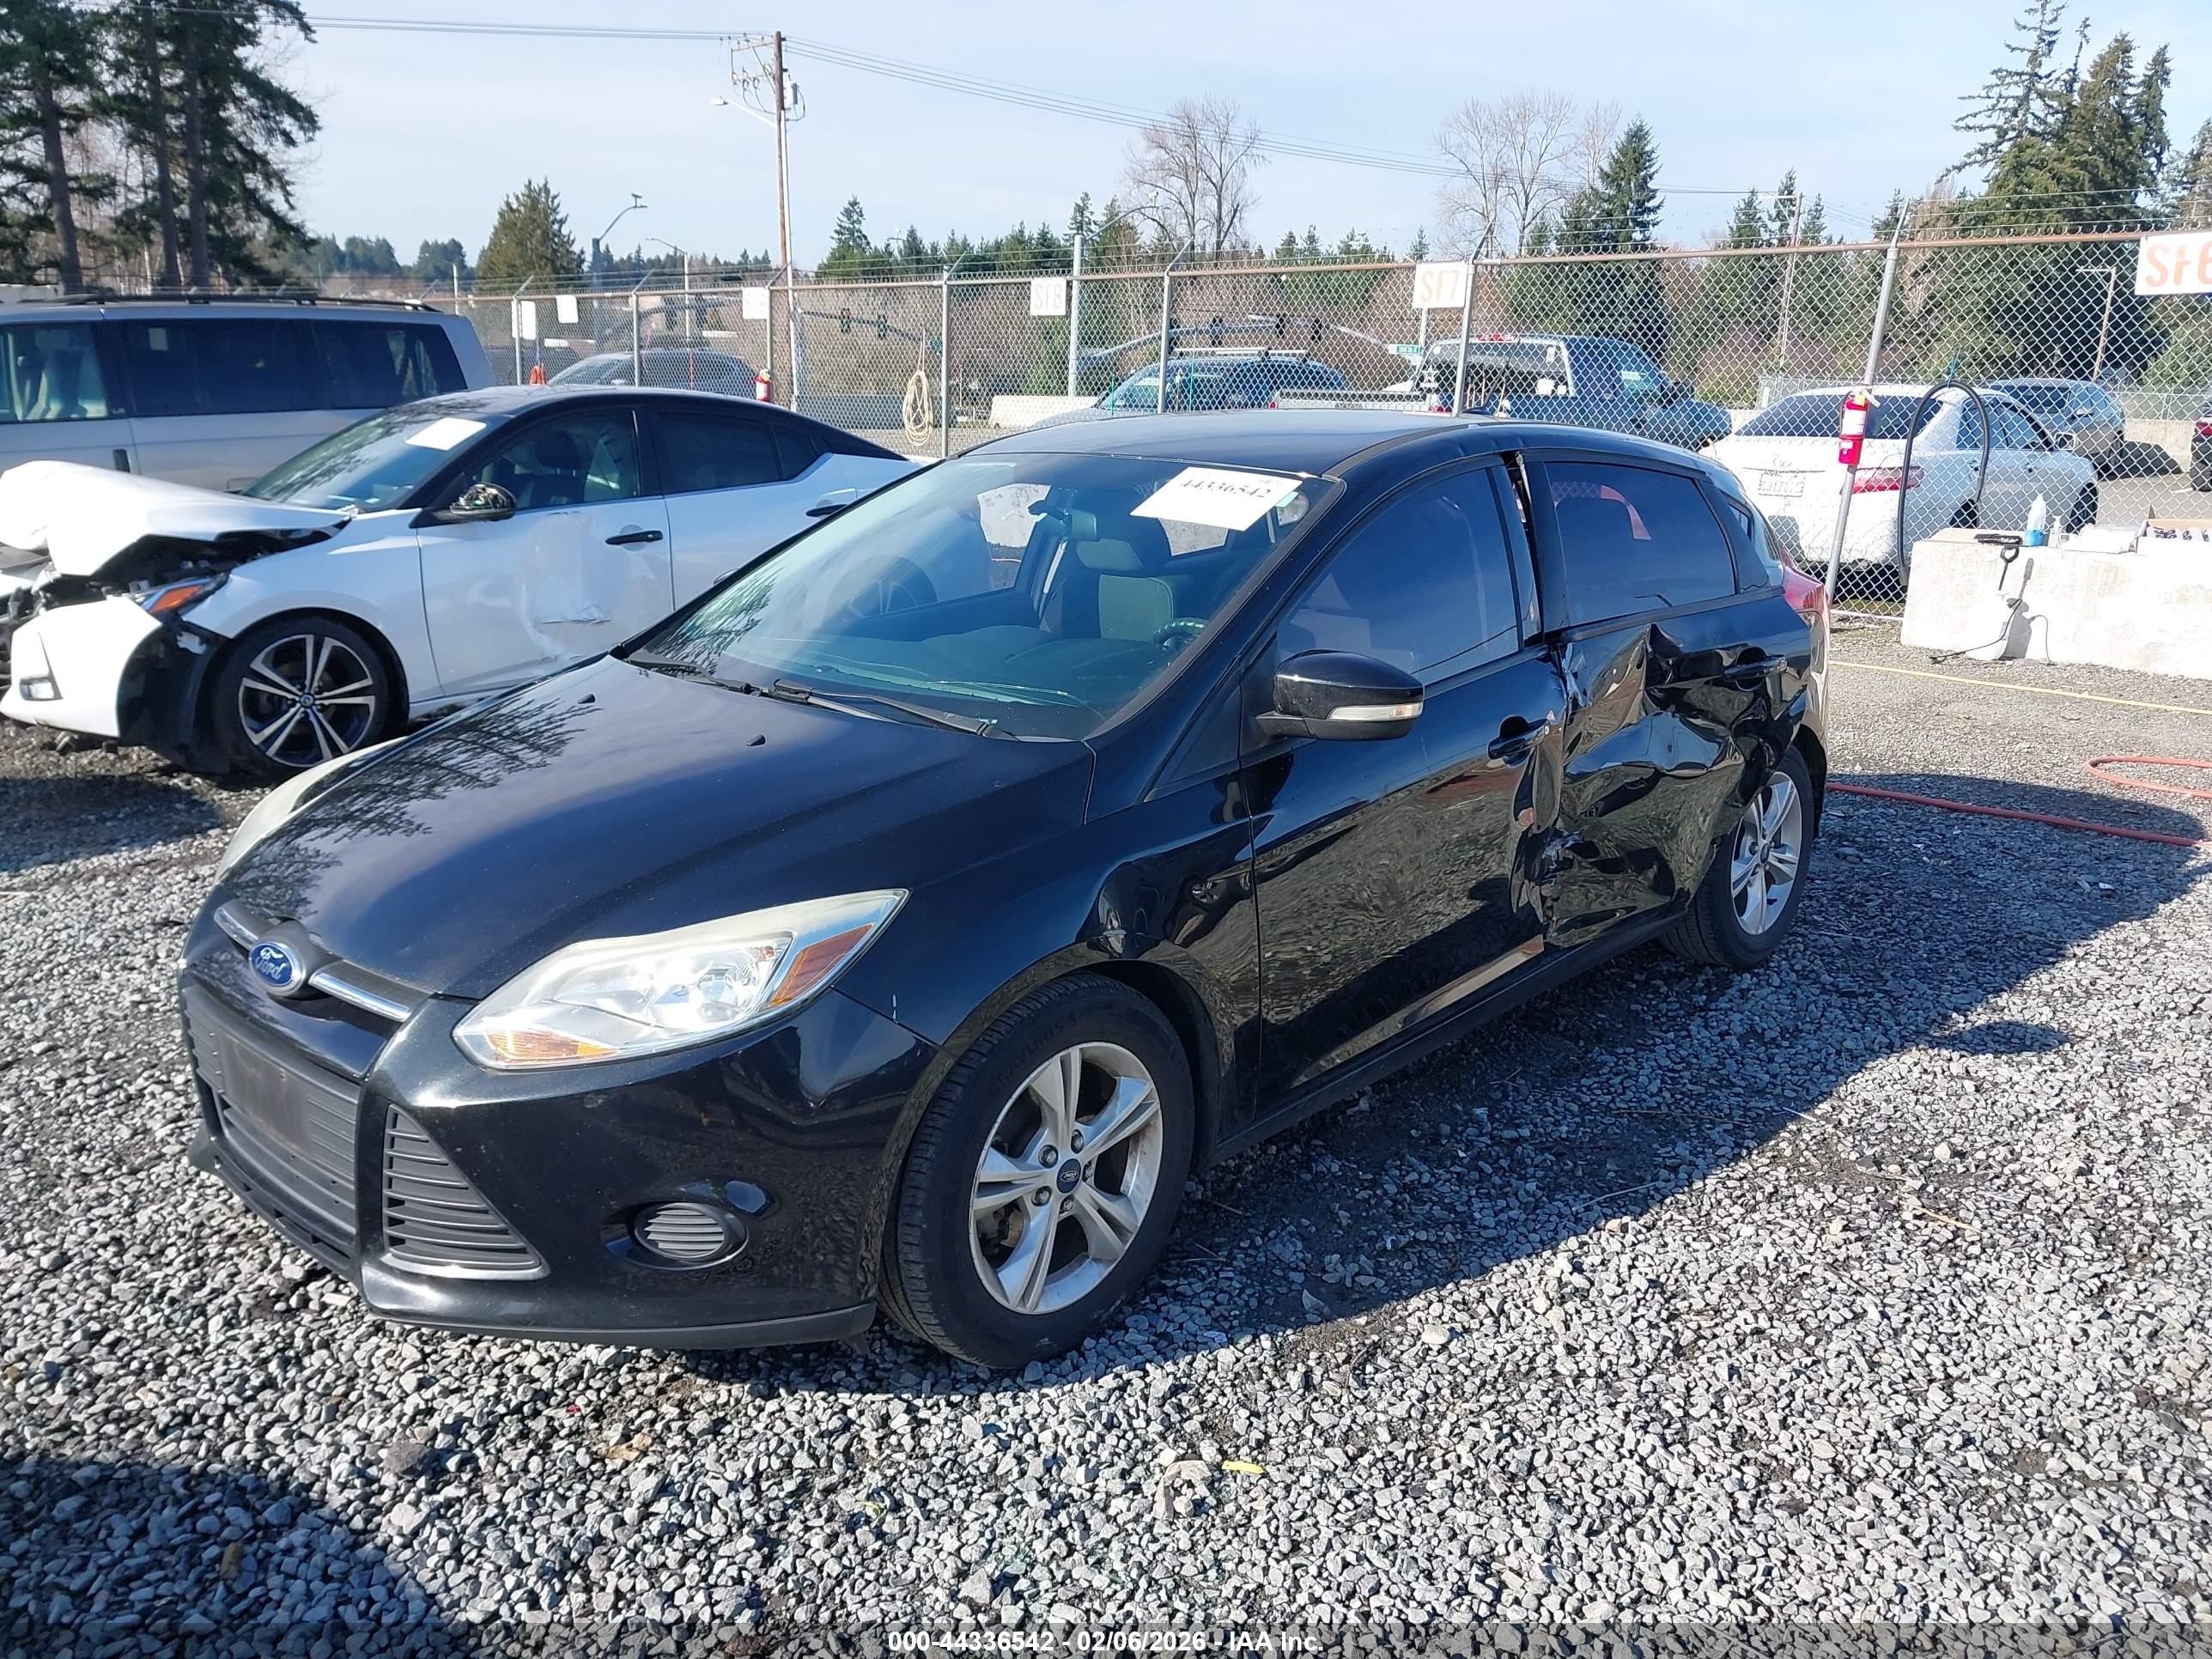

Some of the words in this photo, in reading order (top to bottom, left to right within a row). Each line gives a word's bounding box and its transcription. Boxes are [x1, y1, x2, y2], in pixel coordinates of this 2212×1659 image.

[1035, 283, 1063, 310] SF8
[1420, 270, 1460, 302] SF7
[1180, 479, 1271, 498] 44336542
[255, 946, 289, 981] Ford
